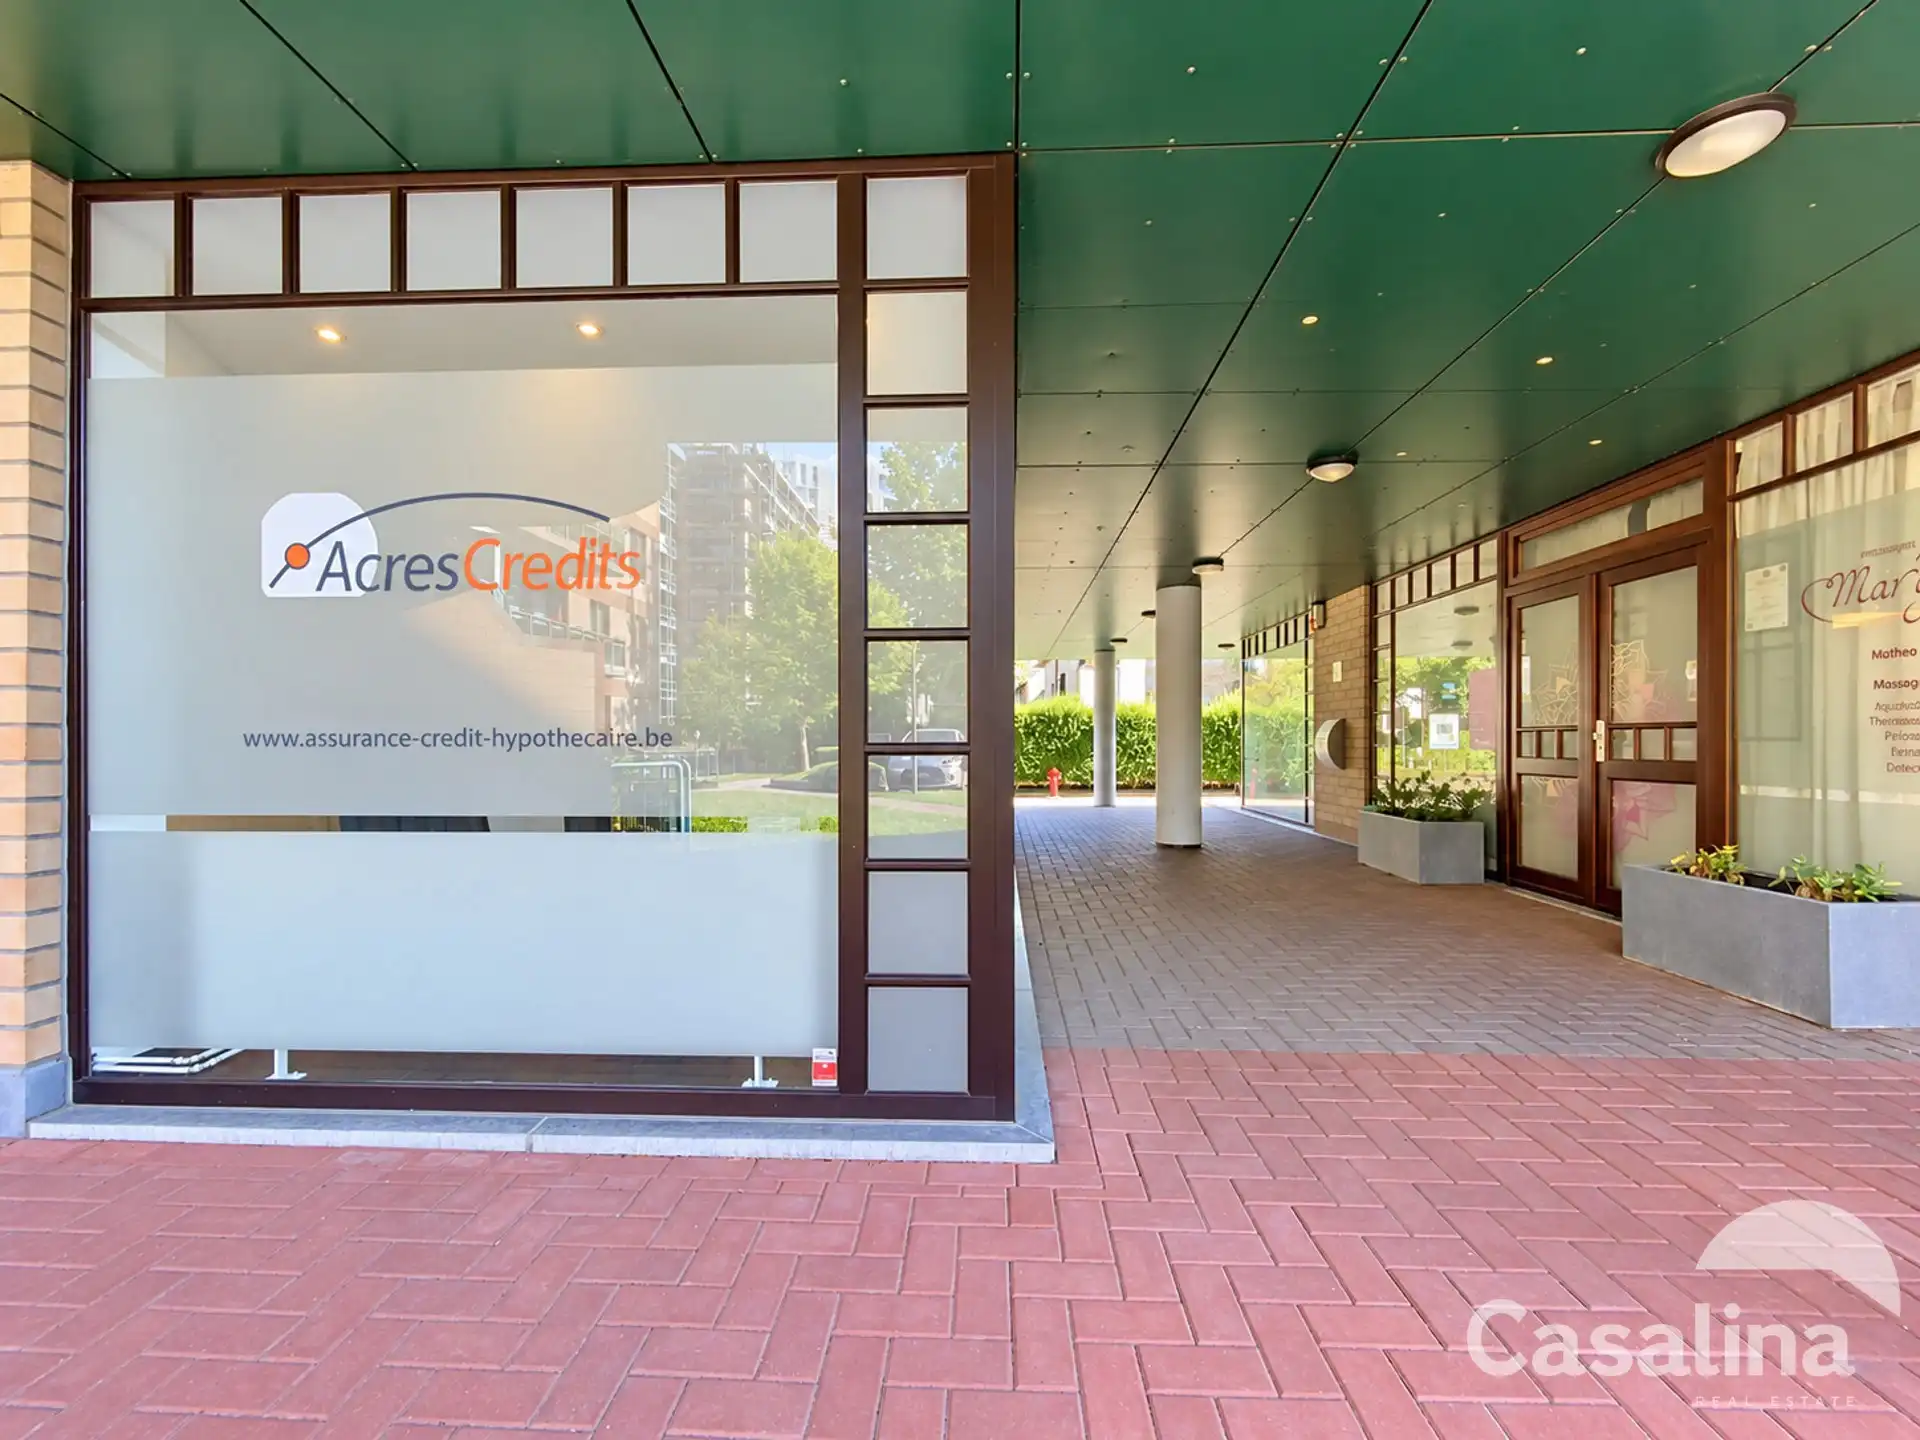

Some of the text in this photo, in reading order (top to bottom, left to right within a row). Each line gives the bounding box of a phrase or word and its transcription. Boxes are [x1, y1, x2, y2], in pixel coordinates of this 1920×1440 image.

[315, 536, 641, 593] AcresCredits
[1873, 679, 1920, 691] Massag
[243, 727, 673, 753] www.assurance-credit-hypothecaire.be
